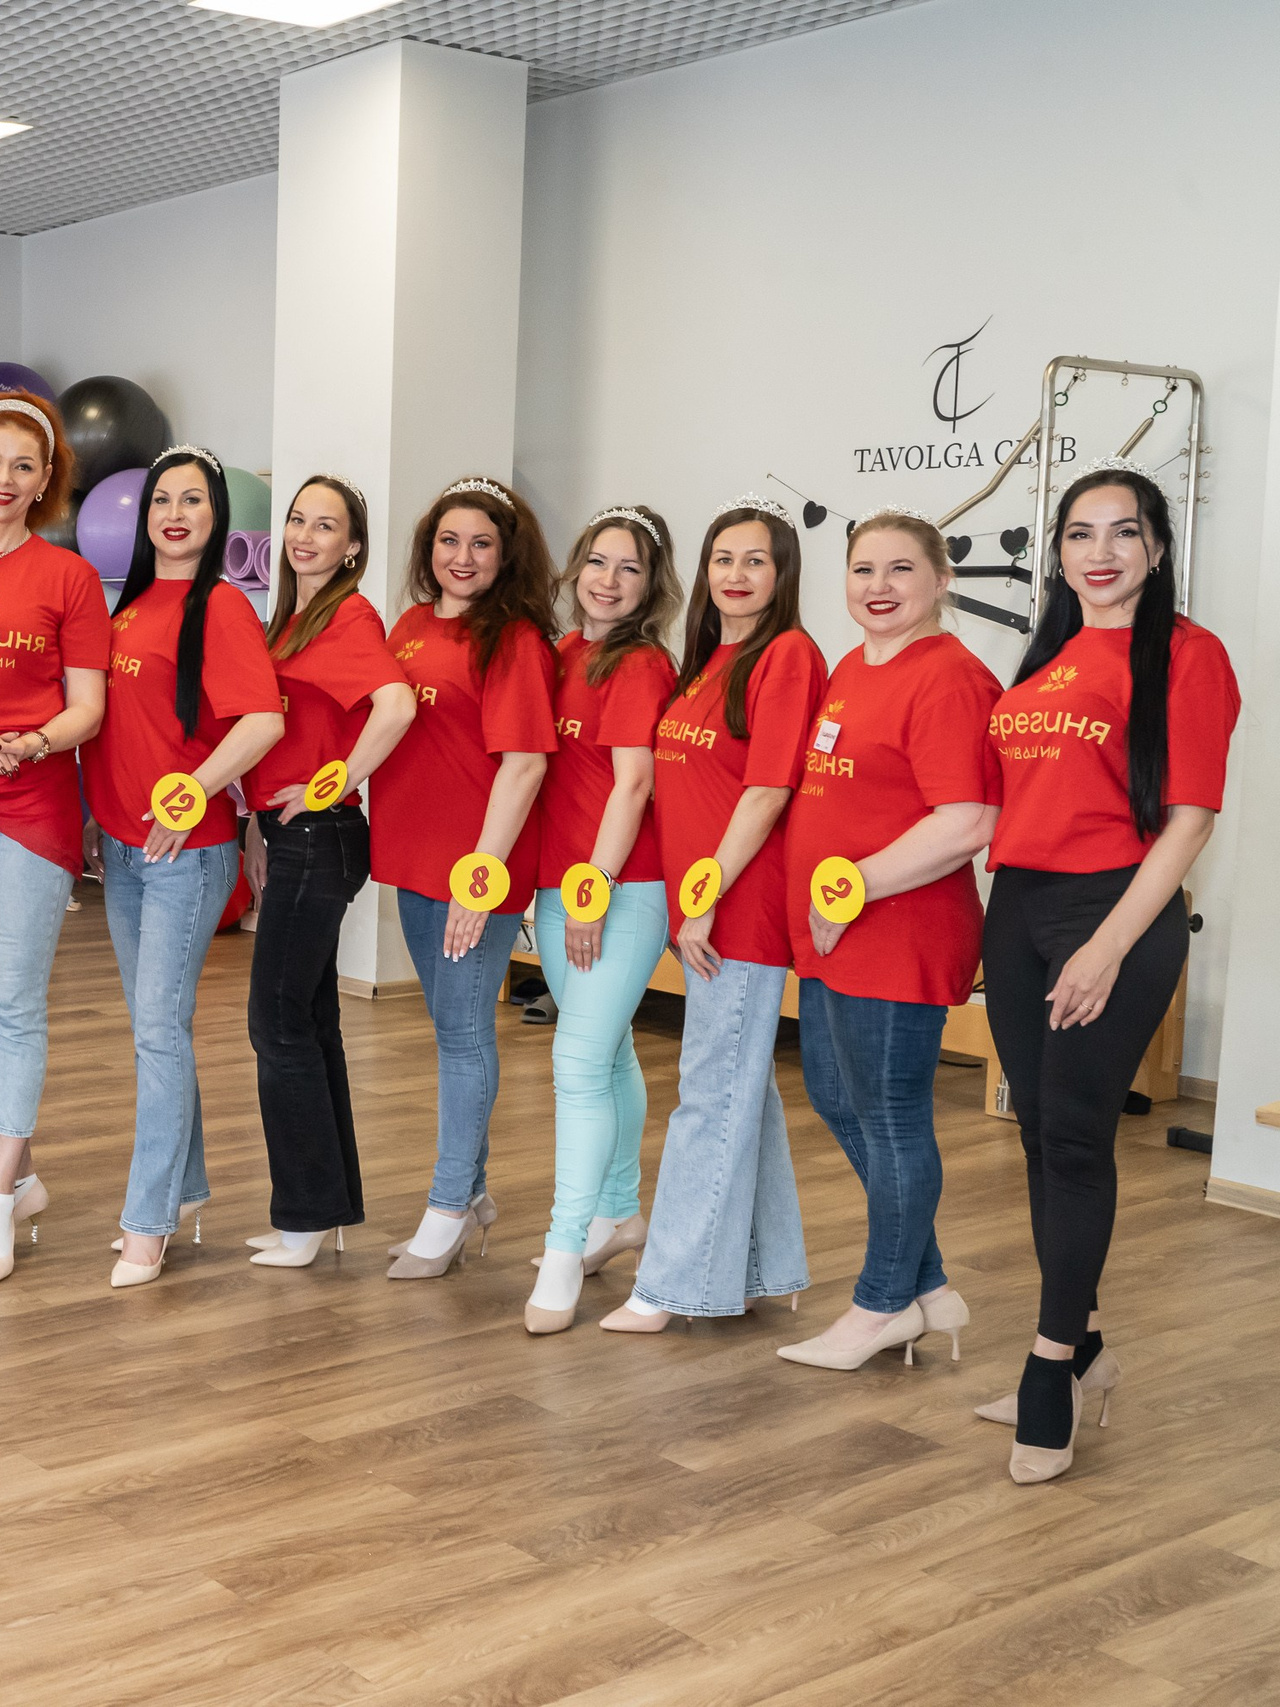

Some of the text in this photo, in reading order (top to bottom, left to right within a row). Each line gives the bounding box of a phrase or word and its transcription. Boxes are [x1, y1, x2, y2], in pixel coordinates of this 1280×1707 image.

[854, 442, 984, 473] TAVOLGA
[159, 782, 196, 823] 12
[468, 865, 490, 899] 8
[577, 878, 595, 907] 6
[690, 872, 711, 906] 4
[820, 877, 853, 906] 2
